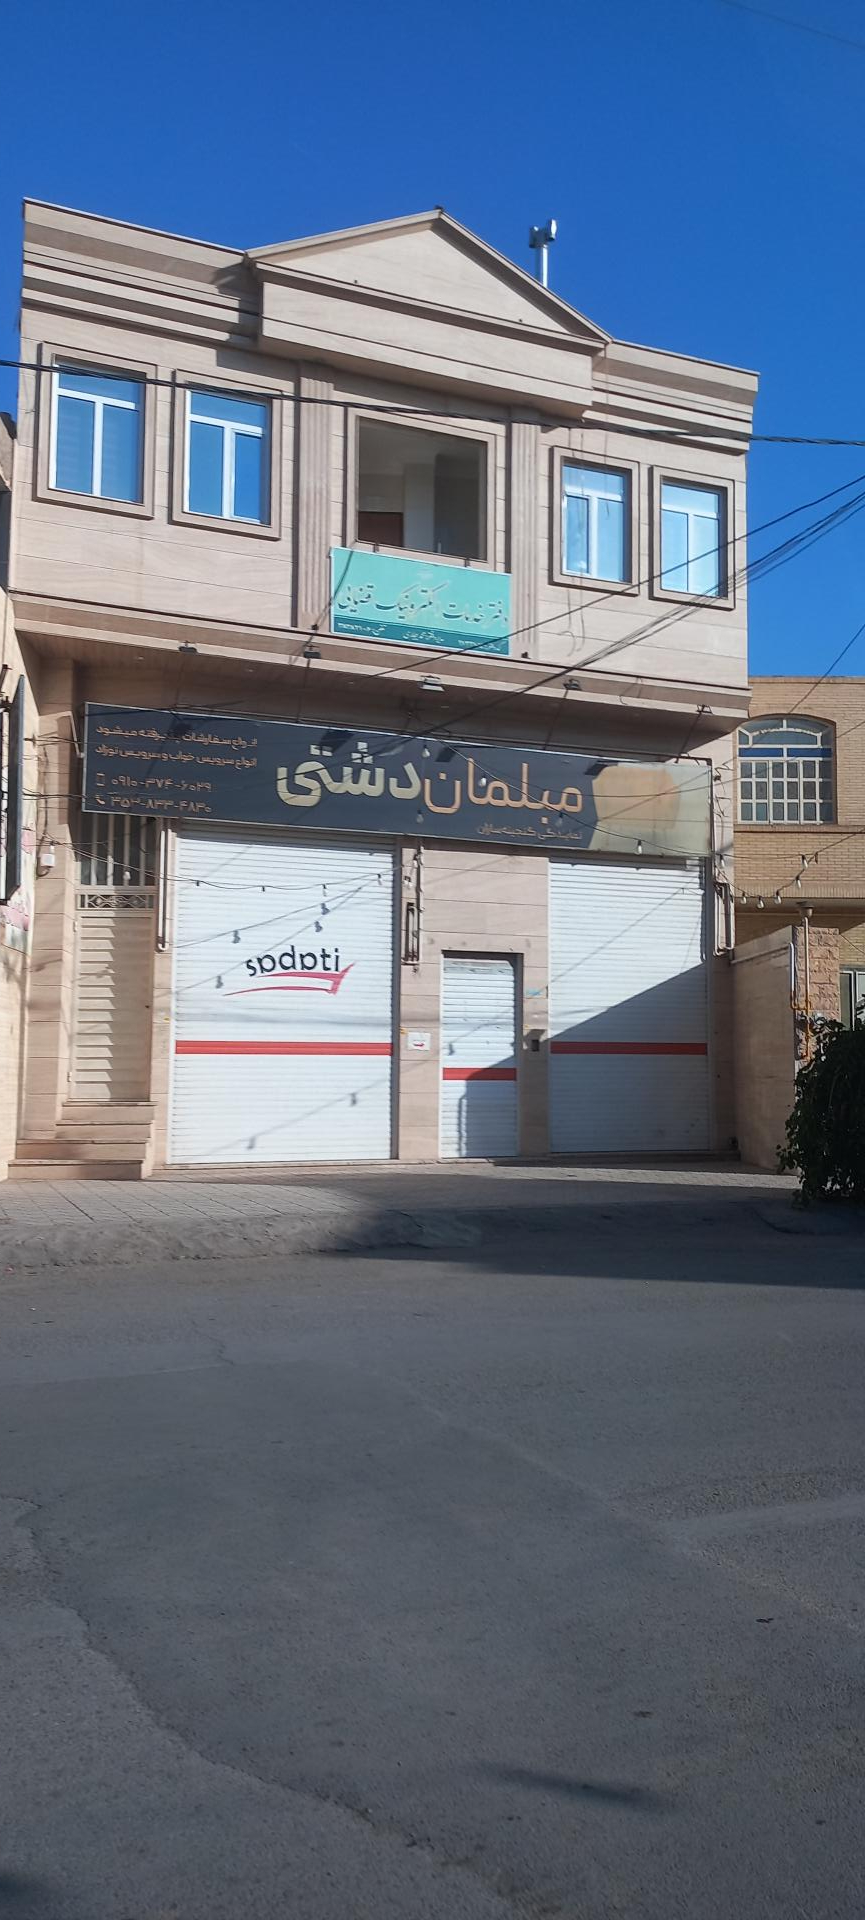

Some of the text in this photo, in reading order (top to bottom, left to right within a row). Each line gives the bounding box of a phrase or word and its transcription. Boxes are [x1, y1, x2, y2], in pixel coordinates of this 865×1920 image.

[442, 602, 484, 624] خدمات
[96, 726, 138, 737] میشود
[182, 732, 231, 746] سفارشات
[231, 736, 258, 750] انواع
[95, 744, 119, 757] نوزاد
[119, 749, 161, 760] سرویس
[169, 750, 195, 763] خواب
[196, 755, 235, 766] سرویس
[235, 756, 258, 770] انواع
[276, 741, 583, 824] مبلمان دشتی
